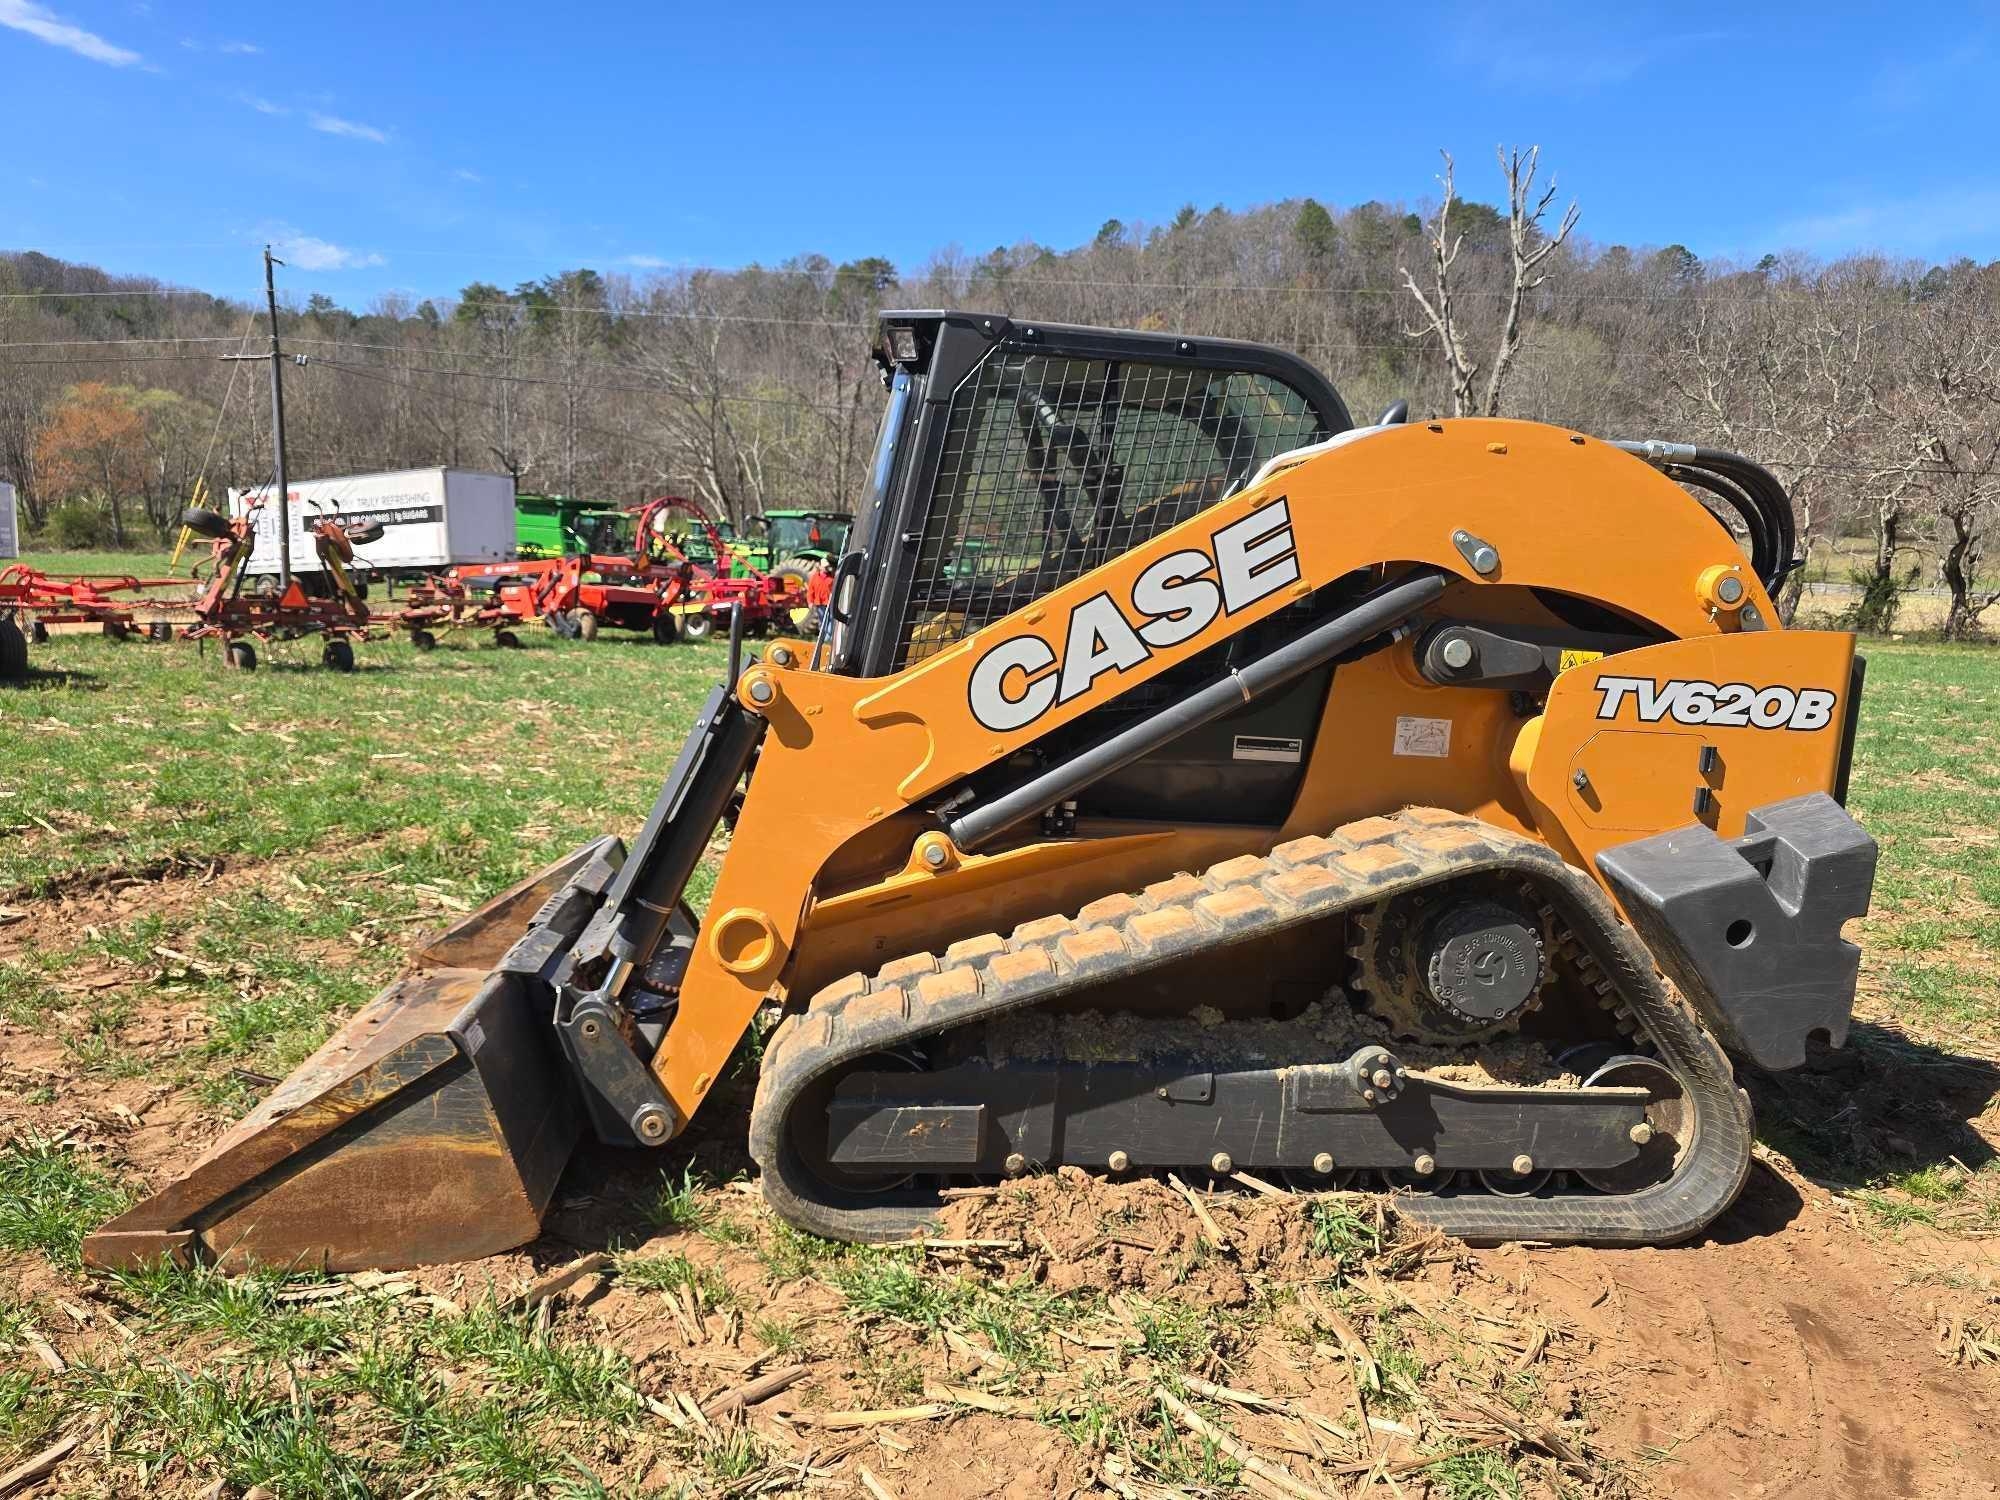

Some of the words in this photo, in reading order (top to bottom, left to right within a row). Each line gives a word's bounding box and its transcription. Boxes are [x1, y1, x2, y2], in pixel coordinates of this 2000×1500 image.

[381, 491, 431, 506] REFRESHING
[968, 495, 1301, 732] CASE
[1593, 675, 1837, 731] TV620B
